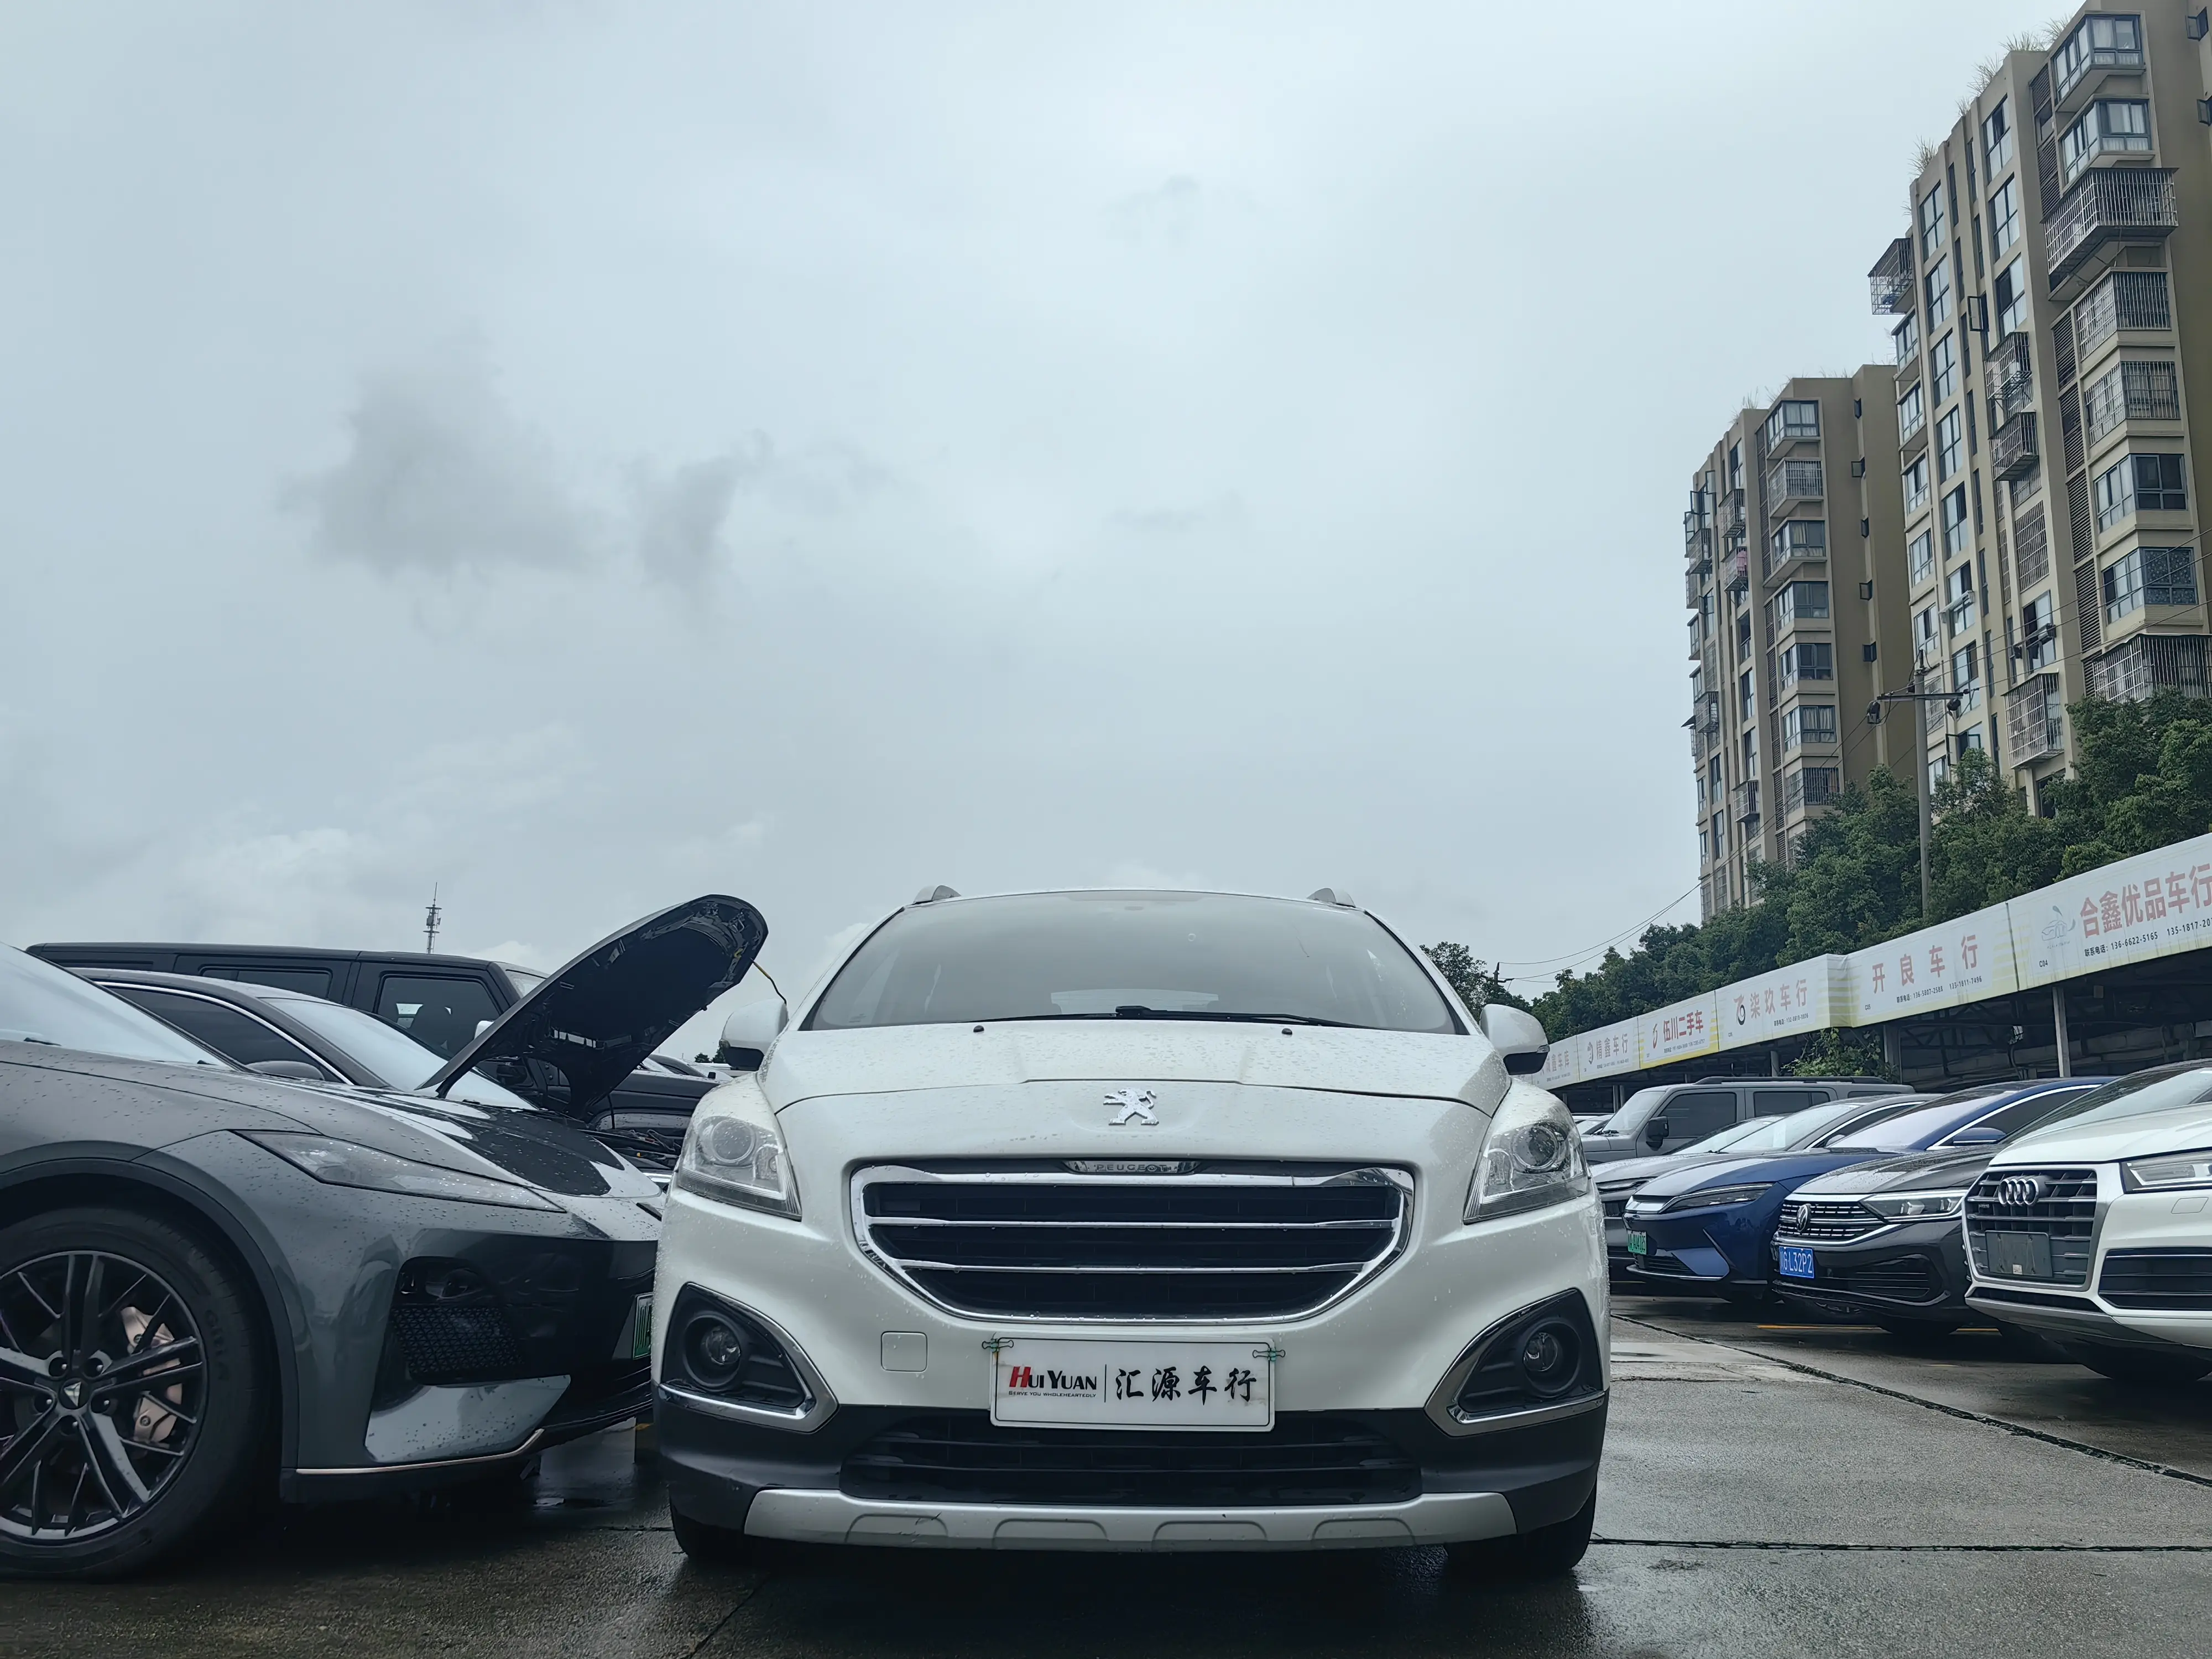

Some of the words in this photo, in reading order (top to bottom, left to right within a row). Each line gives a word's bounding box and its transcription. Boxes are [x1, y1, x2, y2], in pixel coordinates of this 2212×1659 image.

[2080, 863, 2212, 938] 合鑫优品车行
[2111, 932, 2158, 950] 136-6622-5165
[1872, 935, 1978, 994] 开良车行
[1750, 979, 1807, 1019] 柒玖车行
[1663, 1009, 1704, 1043] 伍川二手车
[1096, 1164, 1165, 1172] PEUGEOT
[1115, 1365, 1257, 1406] 汇源车行
